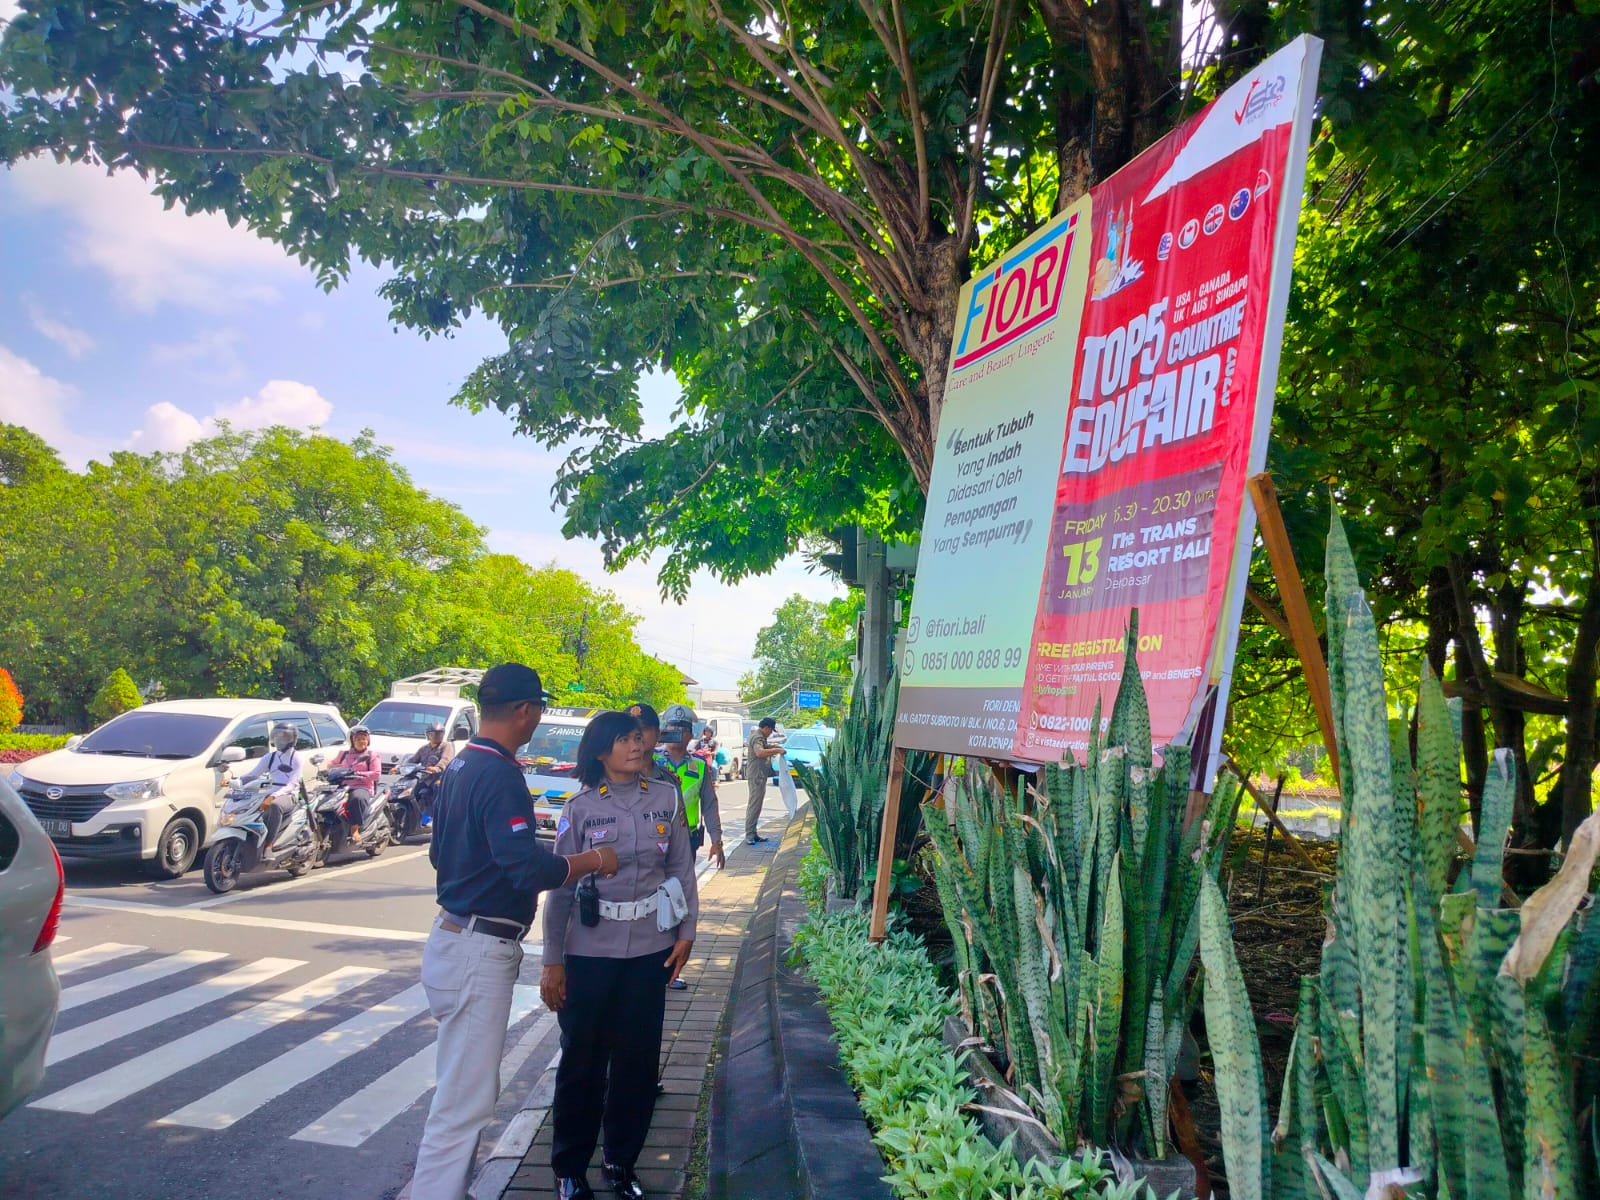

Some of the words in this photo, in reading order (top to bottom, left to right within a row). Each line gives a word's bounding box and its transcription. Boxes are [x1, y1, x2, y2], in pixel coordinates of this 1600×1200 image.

[1176, 290, 1191, 308] USA
[1199, 270, 1231, 297] CANADA
[1174, 307, 1185, 323] UK
[1191, 297, 1208, 316] AUS
[968, 364, 985, 384] and
[986, 353, 1016, 375] Beauty
[1018, 328, 1056, 357] Lingerie
[996, 410, 1035, 440] Tubuh
[956, 456, 985, 479] Yang
[986, 440, 1022, 468] Indah
[946, 475, 995, 505] Didasari
[995, 465, 1023, 489] Oleh
[943, 495, 1018, 528] Penopangan
[1064, 513, 1108, 535] FRIDAY
[1151, 490, 1192, 515] 20.30
[932, 534, 960, 555] Yang
[1140, 517, 1197, 545] TRANS
[1063, 537, 1104, 586] 13
[1107, 546, 1170, 573] RESORT
[1173, 537, 1211, 562] BALI
[925, 614, 986, 638] @fiori.bali
[921, 652, 948, 671] 0851
[951, 650, 973, 670] 000
[976, 649, 1001, 669] 888
[1003, 647, 1022, 668] 99
[1072, 634, 1163, 657] REGISTRAON
[1152, 671, 1167, 680] and
[983, 699, 1001, 712] FIORI
[909, 712, 930, 724] GATOT
[930, 714, 960, 728] SUBROTO
[968, 735, 987, 748] KOTA
